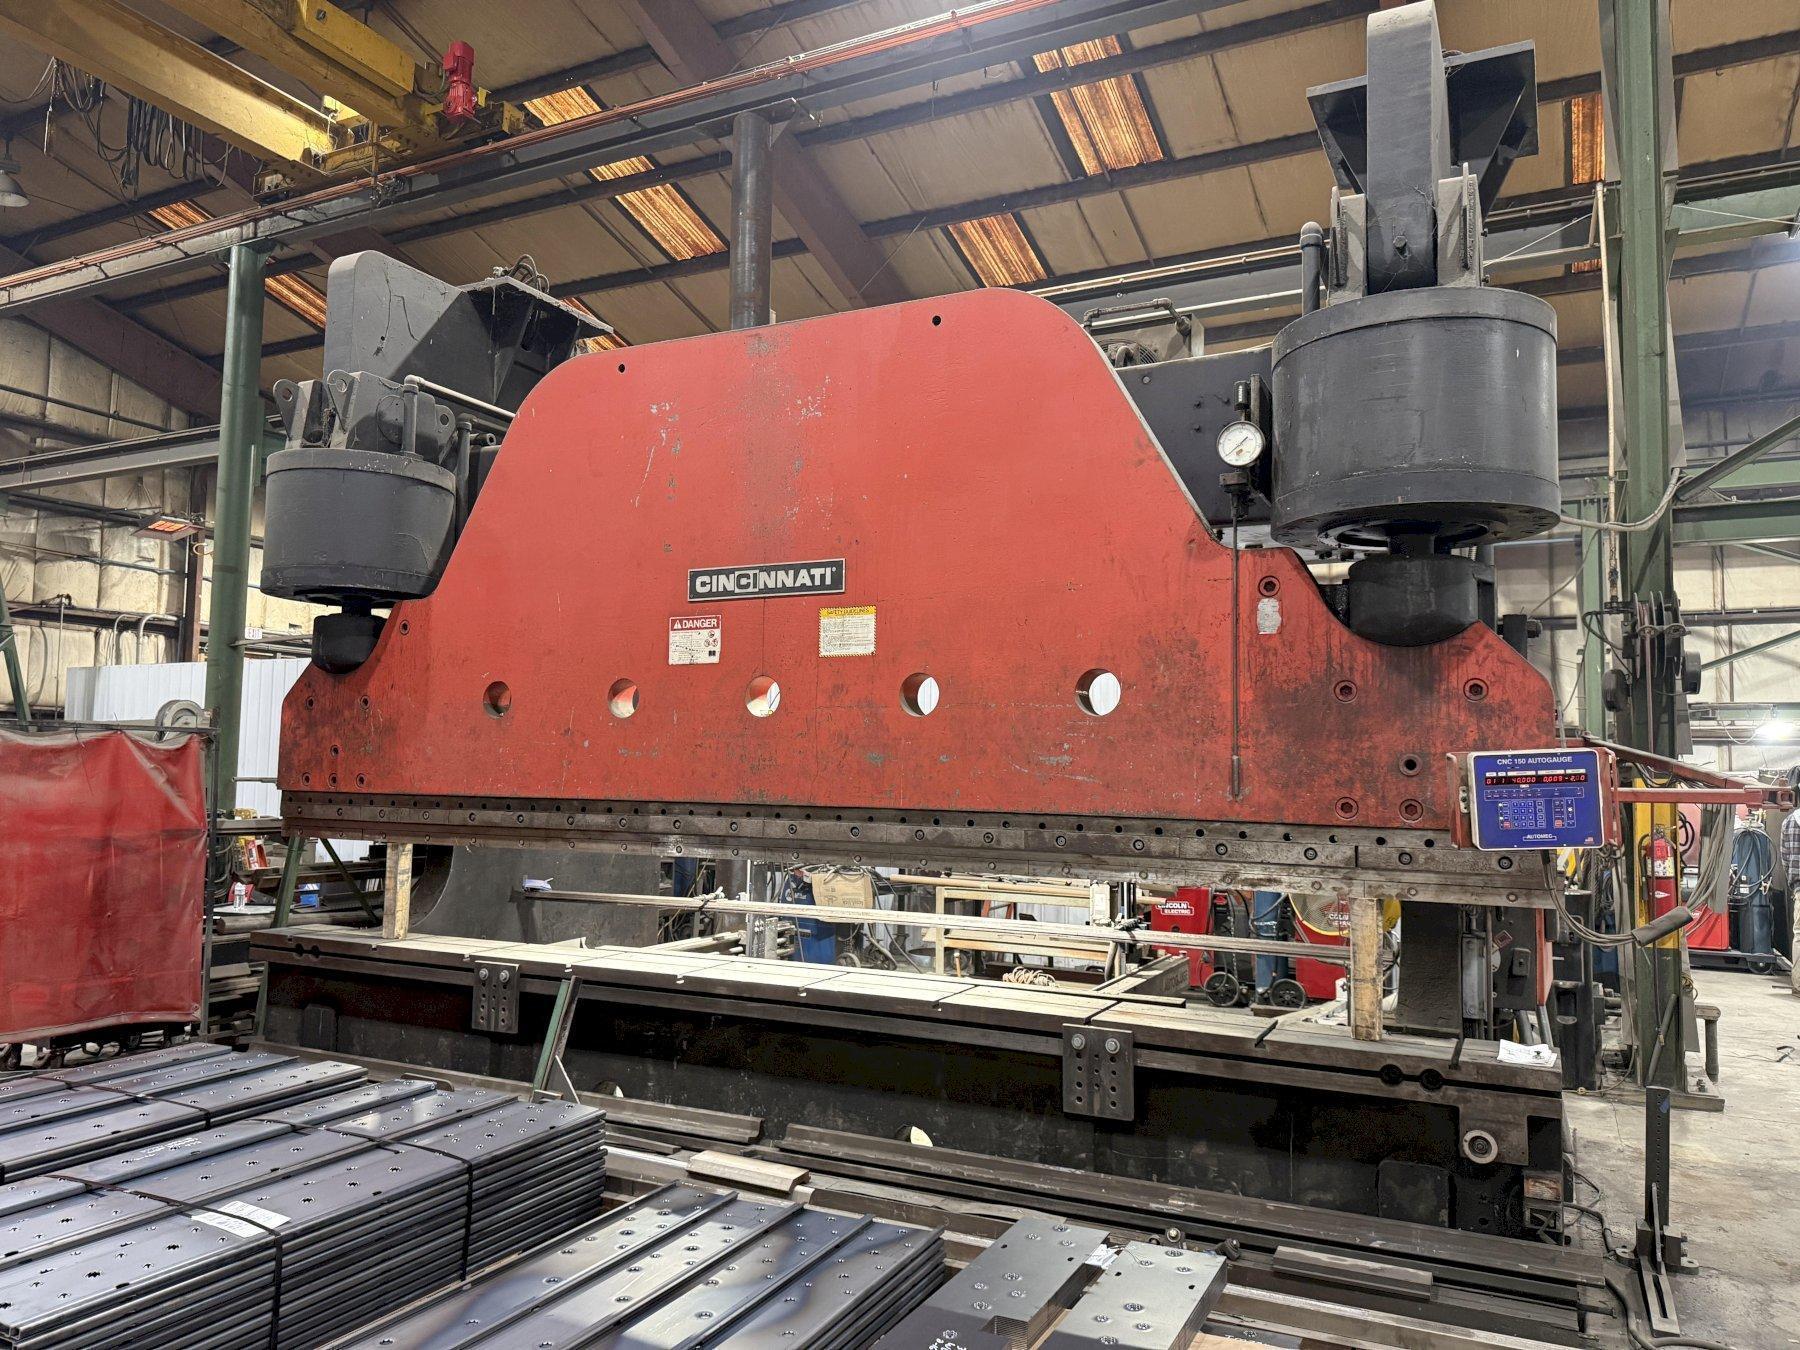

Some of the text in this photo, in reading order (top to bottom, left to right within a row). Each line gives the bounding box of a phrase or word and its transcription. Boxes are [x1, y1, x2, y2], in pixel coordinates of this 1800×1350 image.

[695, 567, 832, 593] CINCINNATI
[682, 619, 718, 630] DANGER
[1527, 756, 1573, 764] AUTOGAUGE
